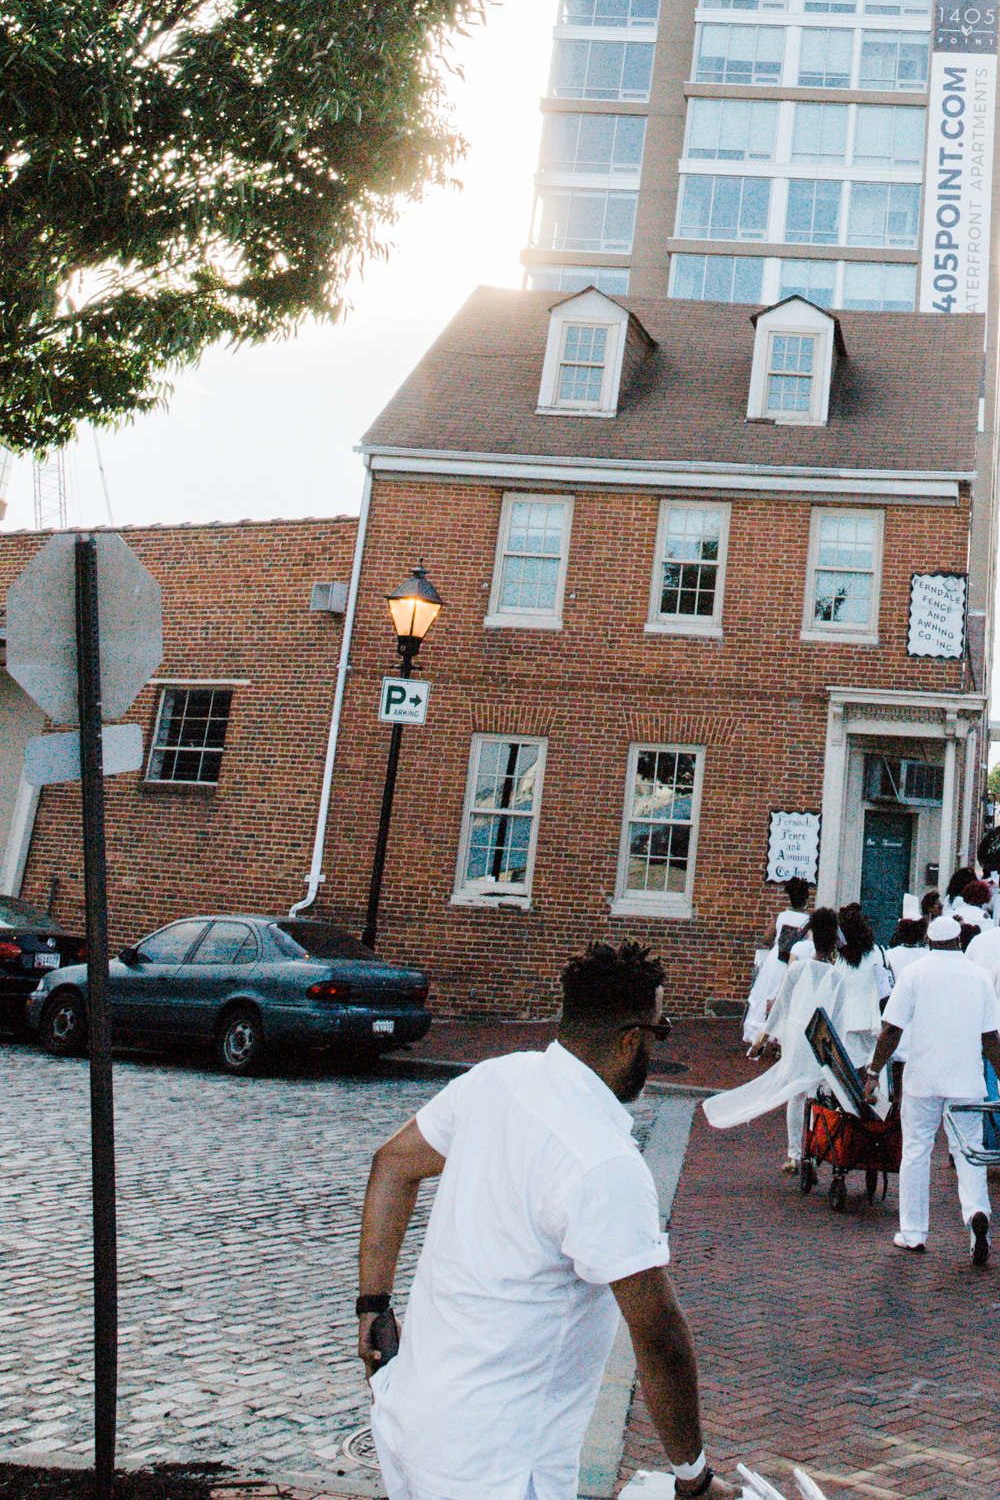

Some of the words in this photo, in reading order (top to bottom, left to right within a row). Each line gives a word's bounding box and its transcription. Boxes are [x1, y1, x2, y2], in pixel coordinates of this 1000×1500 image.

[939, 7, 995, 25] 1405
[938, 37, 994, 46] POINT
[970, 68, 988, 191] APARTMENTS
[932, 66, 967, 314] 405POINT.COM
[965, 200, 983, 313] ATERFRONT
[914, 578, 961, 604] FERNDALE
[922, 595, 952, 613] FENCE
[927, 610, 946, 622] AND
[917, 618, 954, 639] AWNING
[936, 639, 955, 652] INC.
